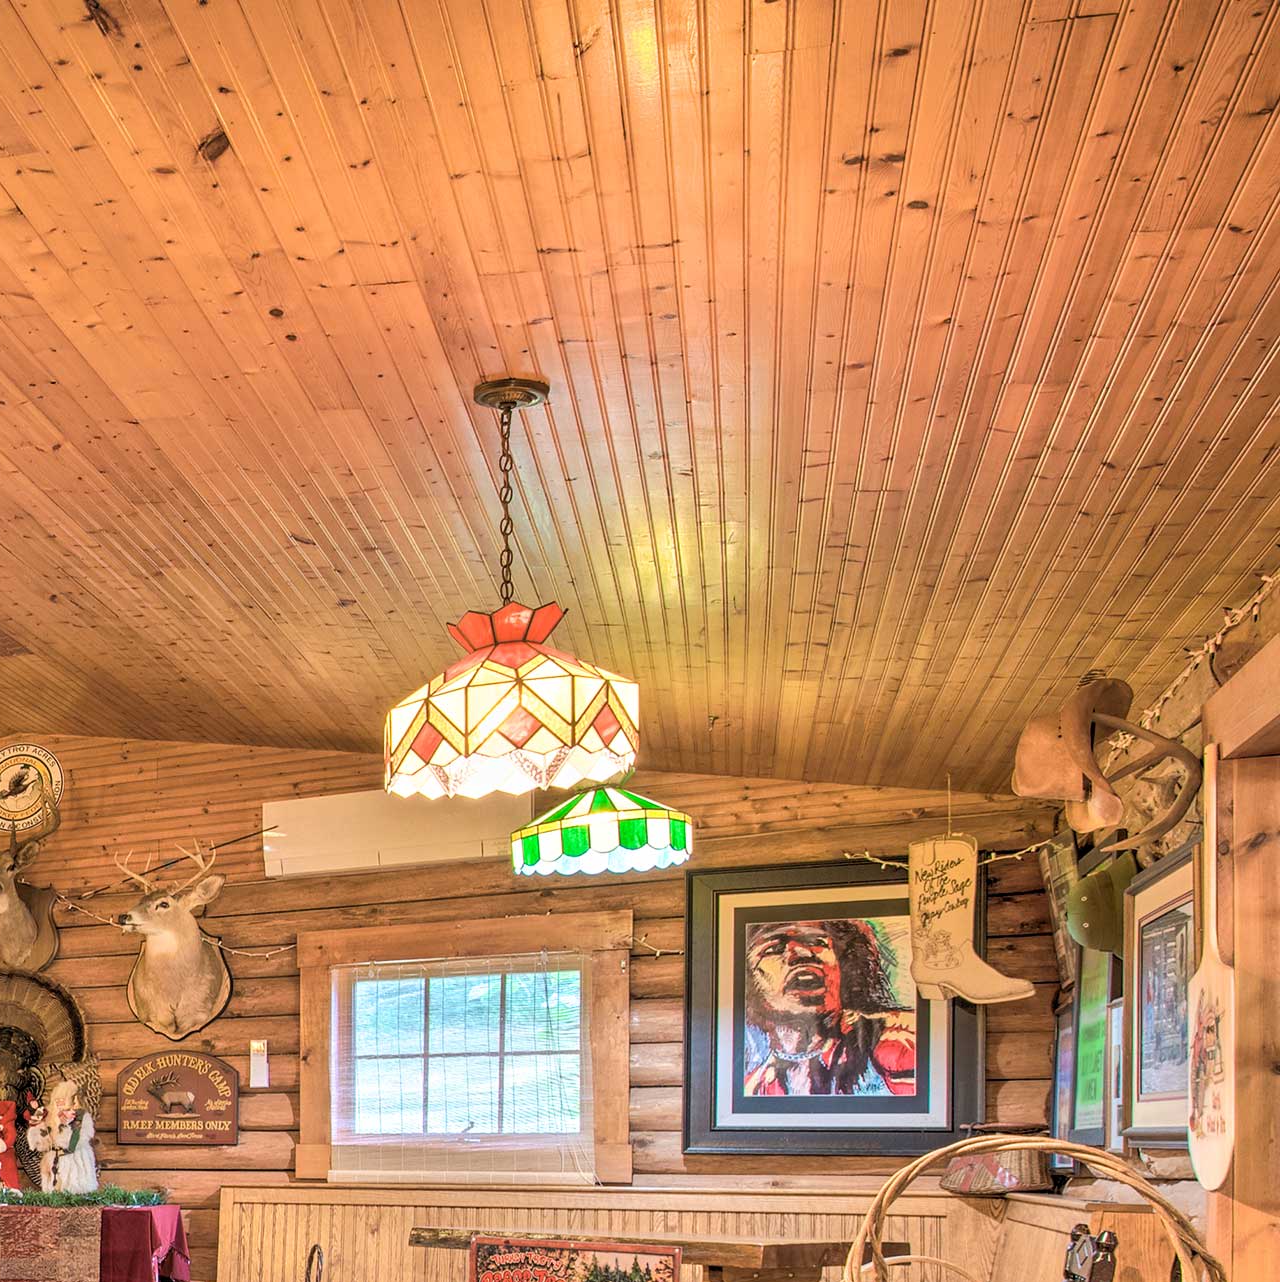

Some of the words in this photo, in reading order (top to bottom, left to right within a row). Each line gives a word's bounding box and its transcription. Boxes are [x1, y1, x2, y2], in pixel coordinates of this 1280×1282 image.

[8, 746, 30, 755] TROT
[32, 748, 55, 768] ACRES
[915, 868, 933, 885] New
[949, 878, 973, 896] Sage
[122, 1076, 140, 1096] OLD
[134, 1062, 158, 1081] ELK
[156, 1054, 212, 1075] HUNTER'S
[208, 1070, 232, 1098] CAMP
[123, 1120, 154, 1130] RMEF
[155, 1120, 203, 1130] MEMBERS
[205, 1120, 232, 1130] ONLY
